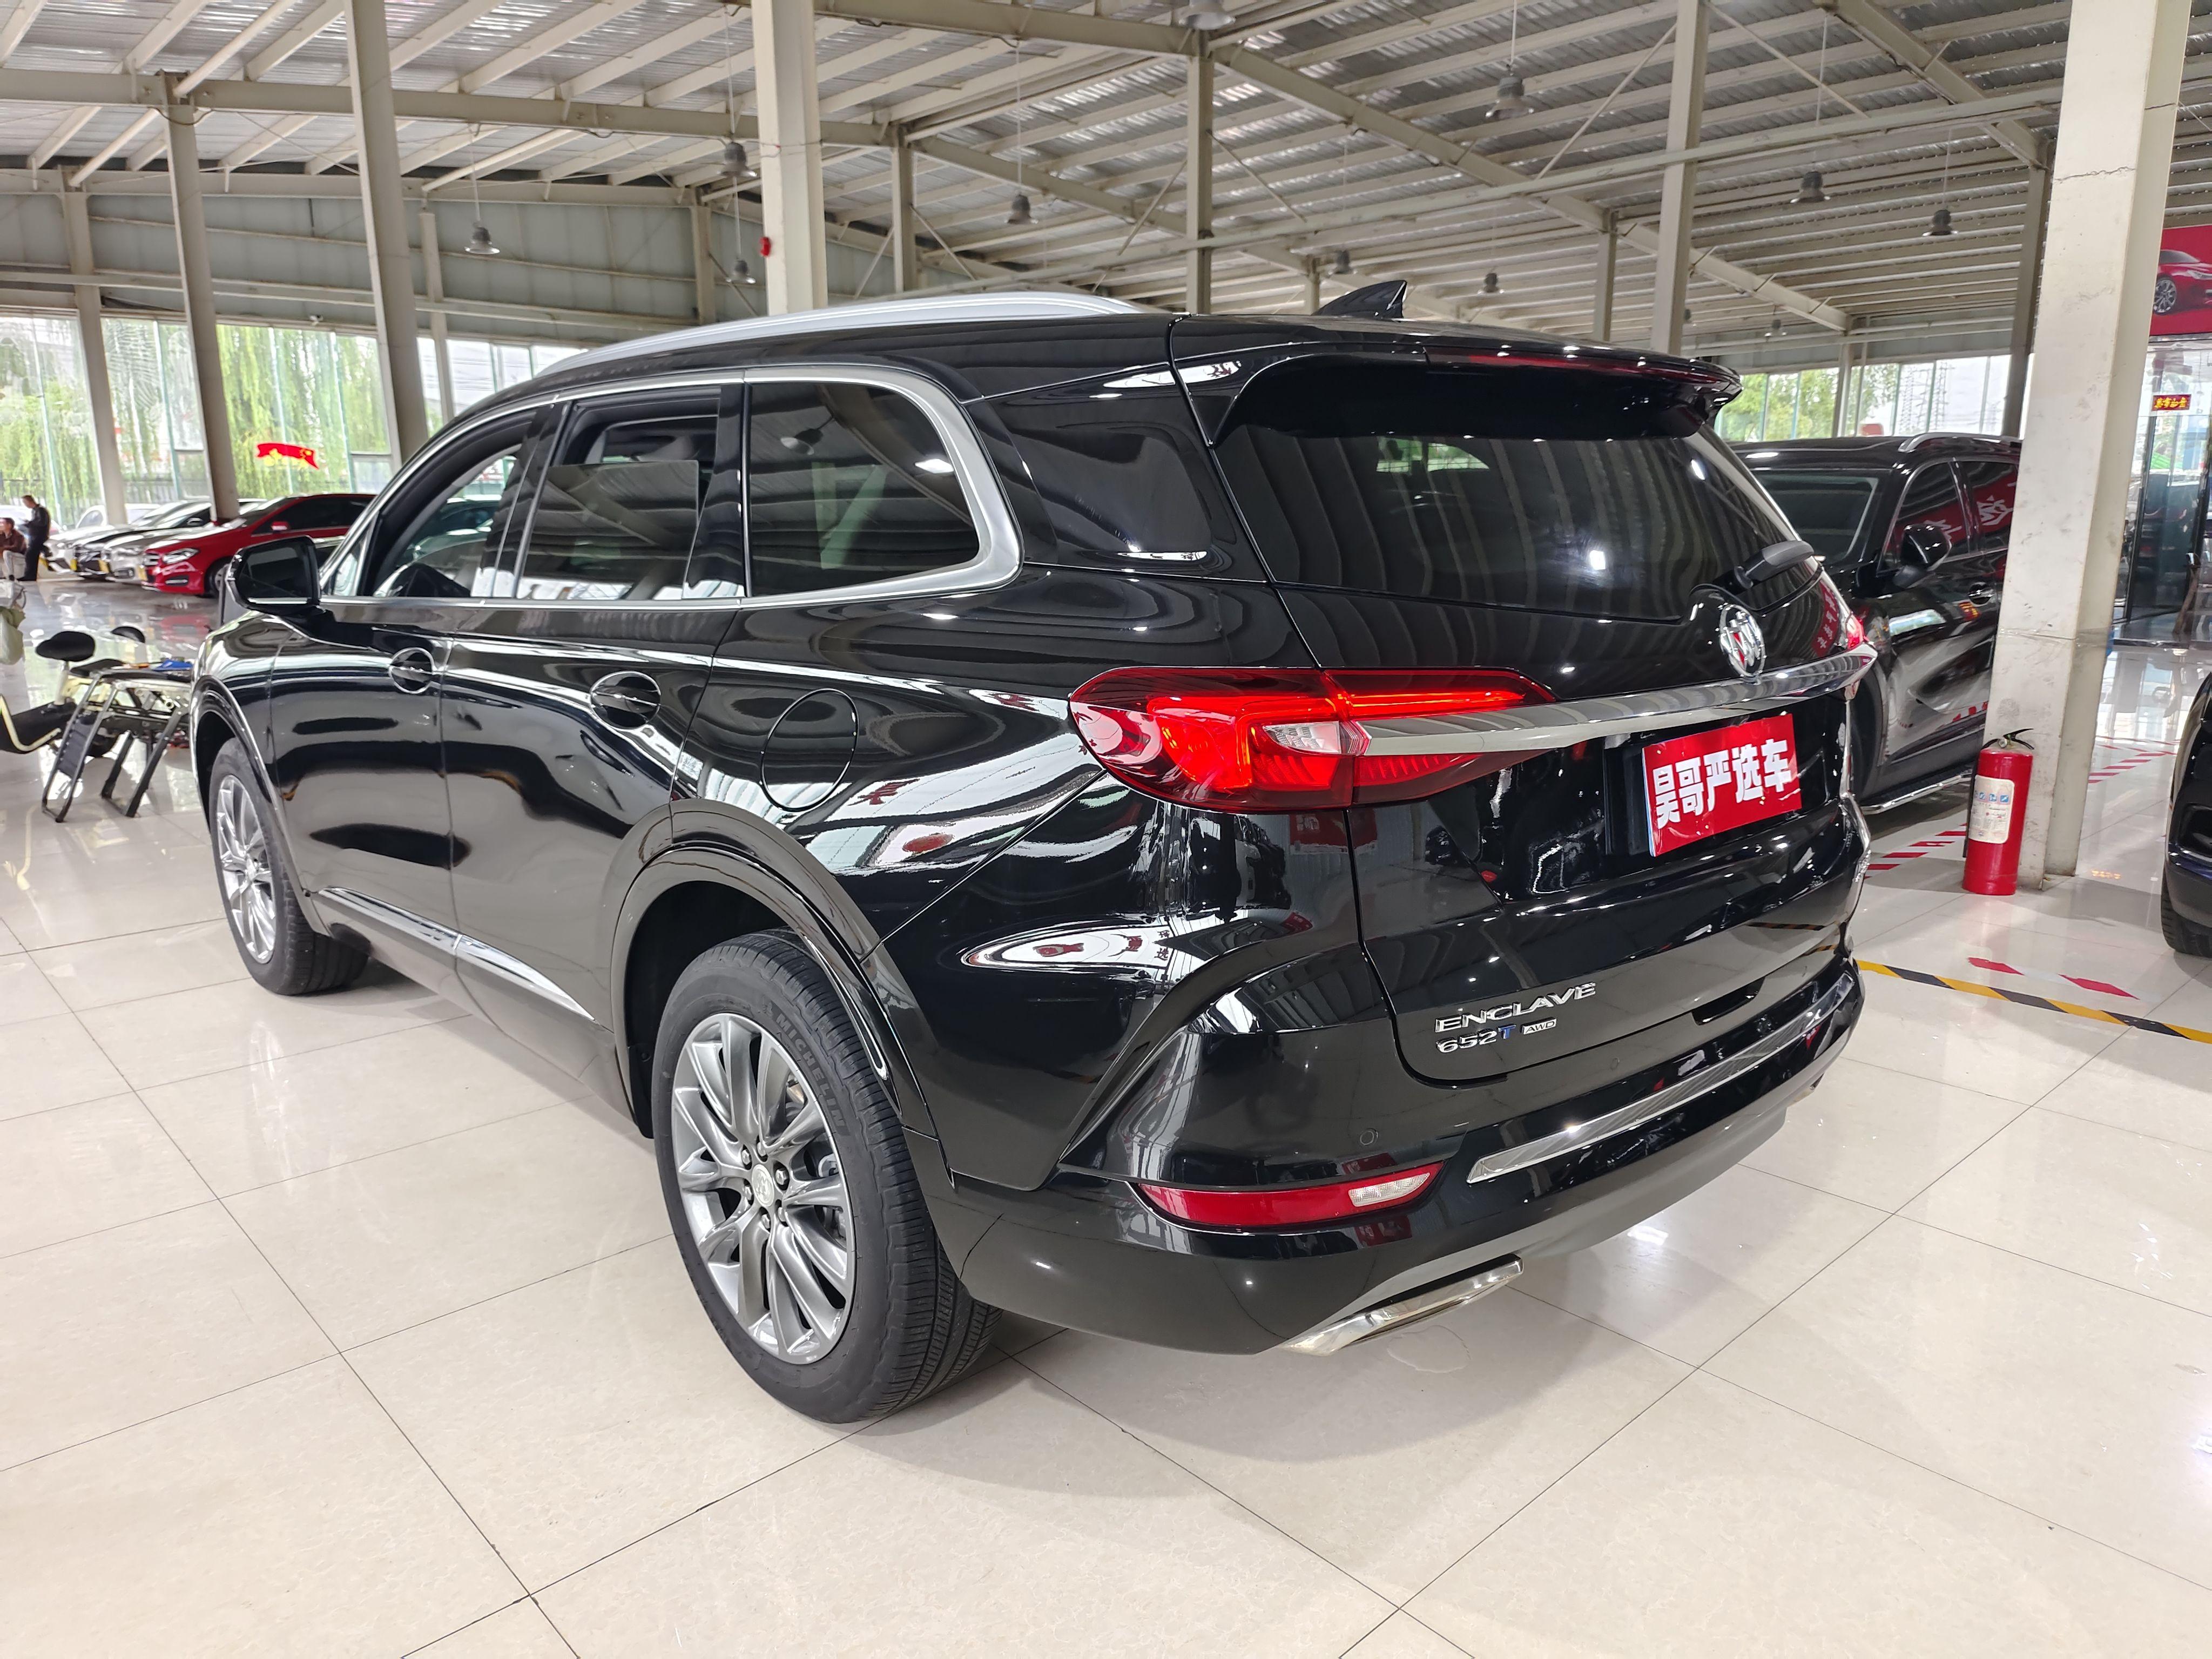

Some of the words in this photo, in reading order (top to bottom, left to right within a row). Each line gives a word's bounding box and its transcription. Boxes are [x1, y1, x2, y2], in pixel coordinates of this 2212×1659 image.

[1435, 981, 1596, 1033] ENCLAVE
[1435, 1023, 1516, 1053] 652T
[1524, 1019, 1556, 1034] AWD
[776, 1013, 846, 1127] MICHELIN
